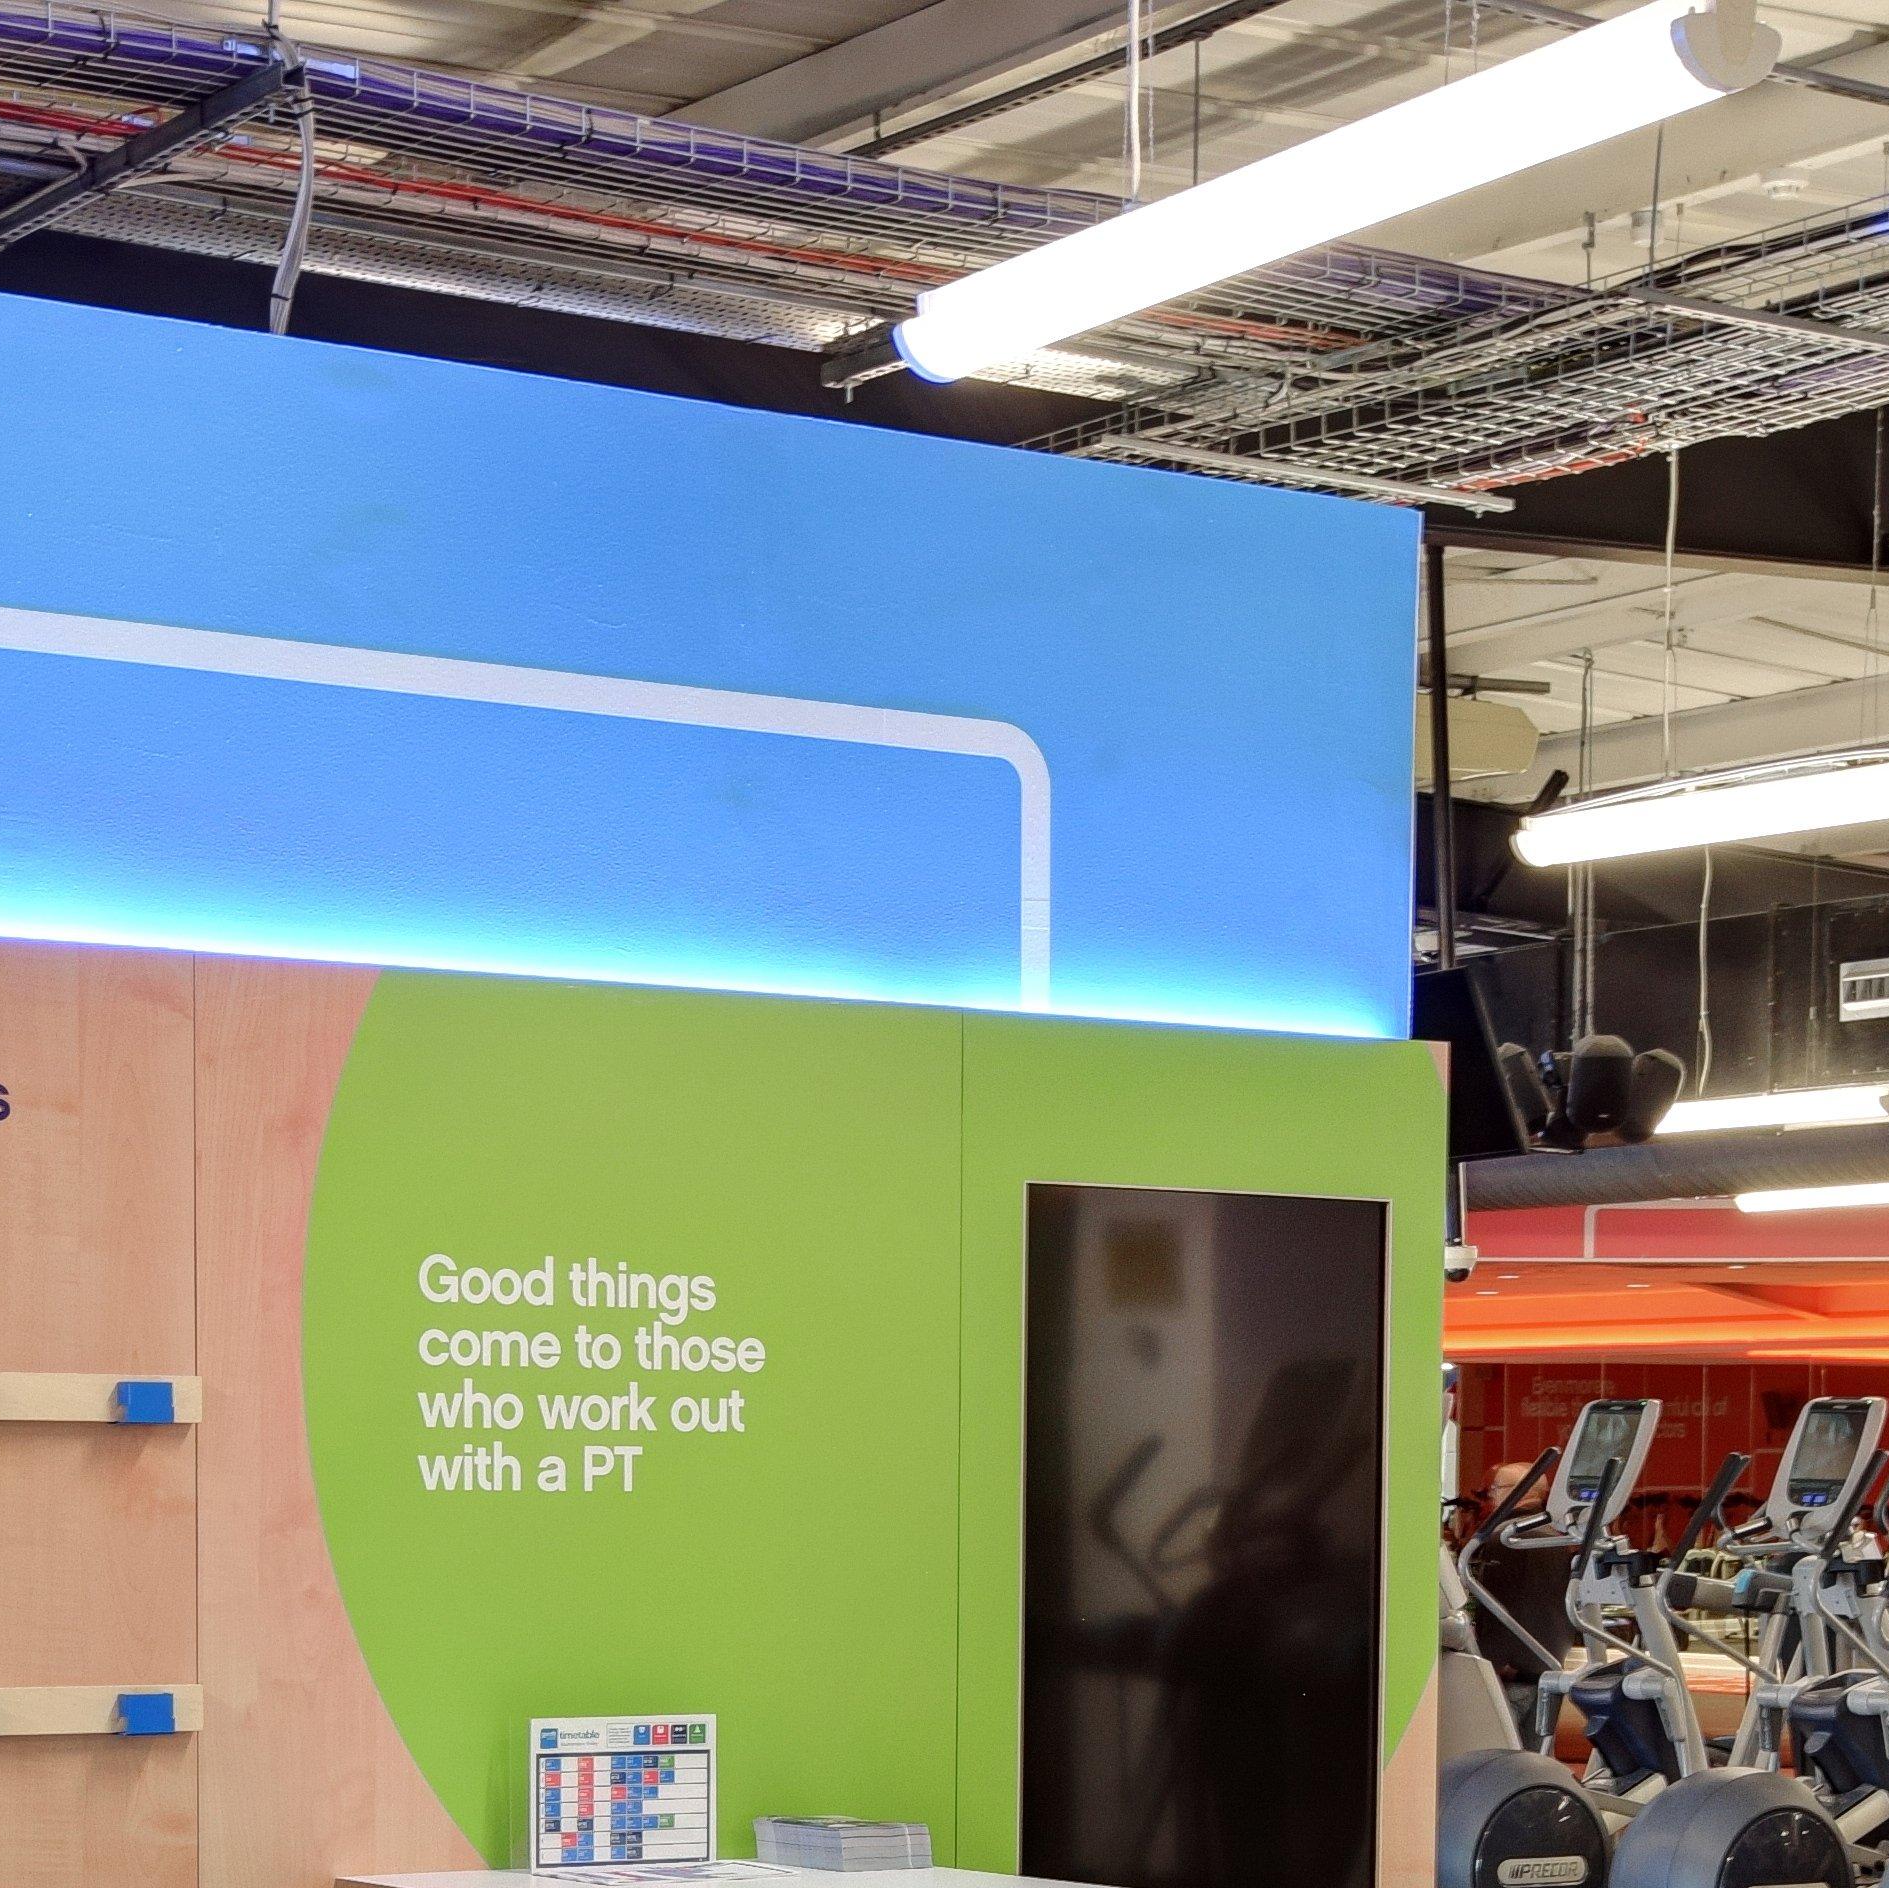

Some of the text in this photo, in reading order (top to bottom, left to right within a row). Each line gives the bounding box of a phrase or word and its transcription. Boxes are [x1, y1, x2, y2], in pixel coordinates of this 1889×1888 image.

[418, 1253, 717, 1325] Good things
[418, 1321, 766, 1373] come to those
[417, 1377, 746, 1433] who work out
[417, 1440, 643, 1492] with a PT
[1518, 1862, 1578, 1878] PRECOR
